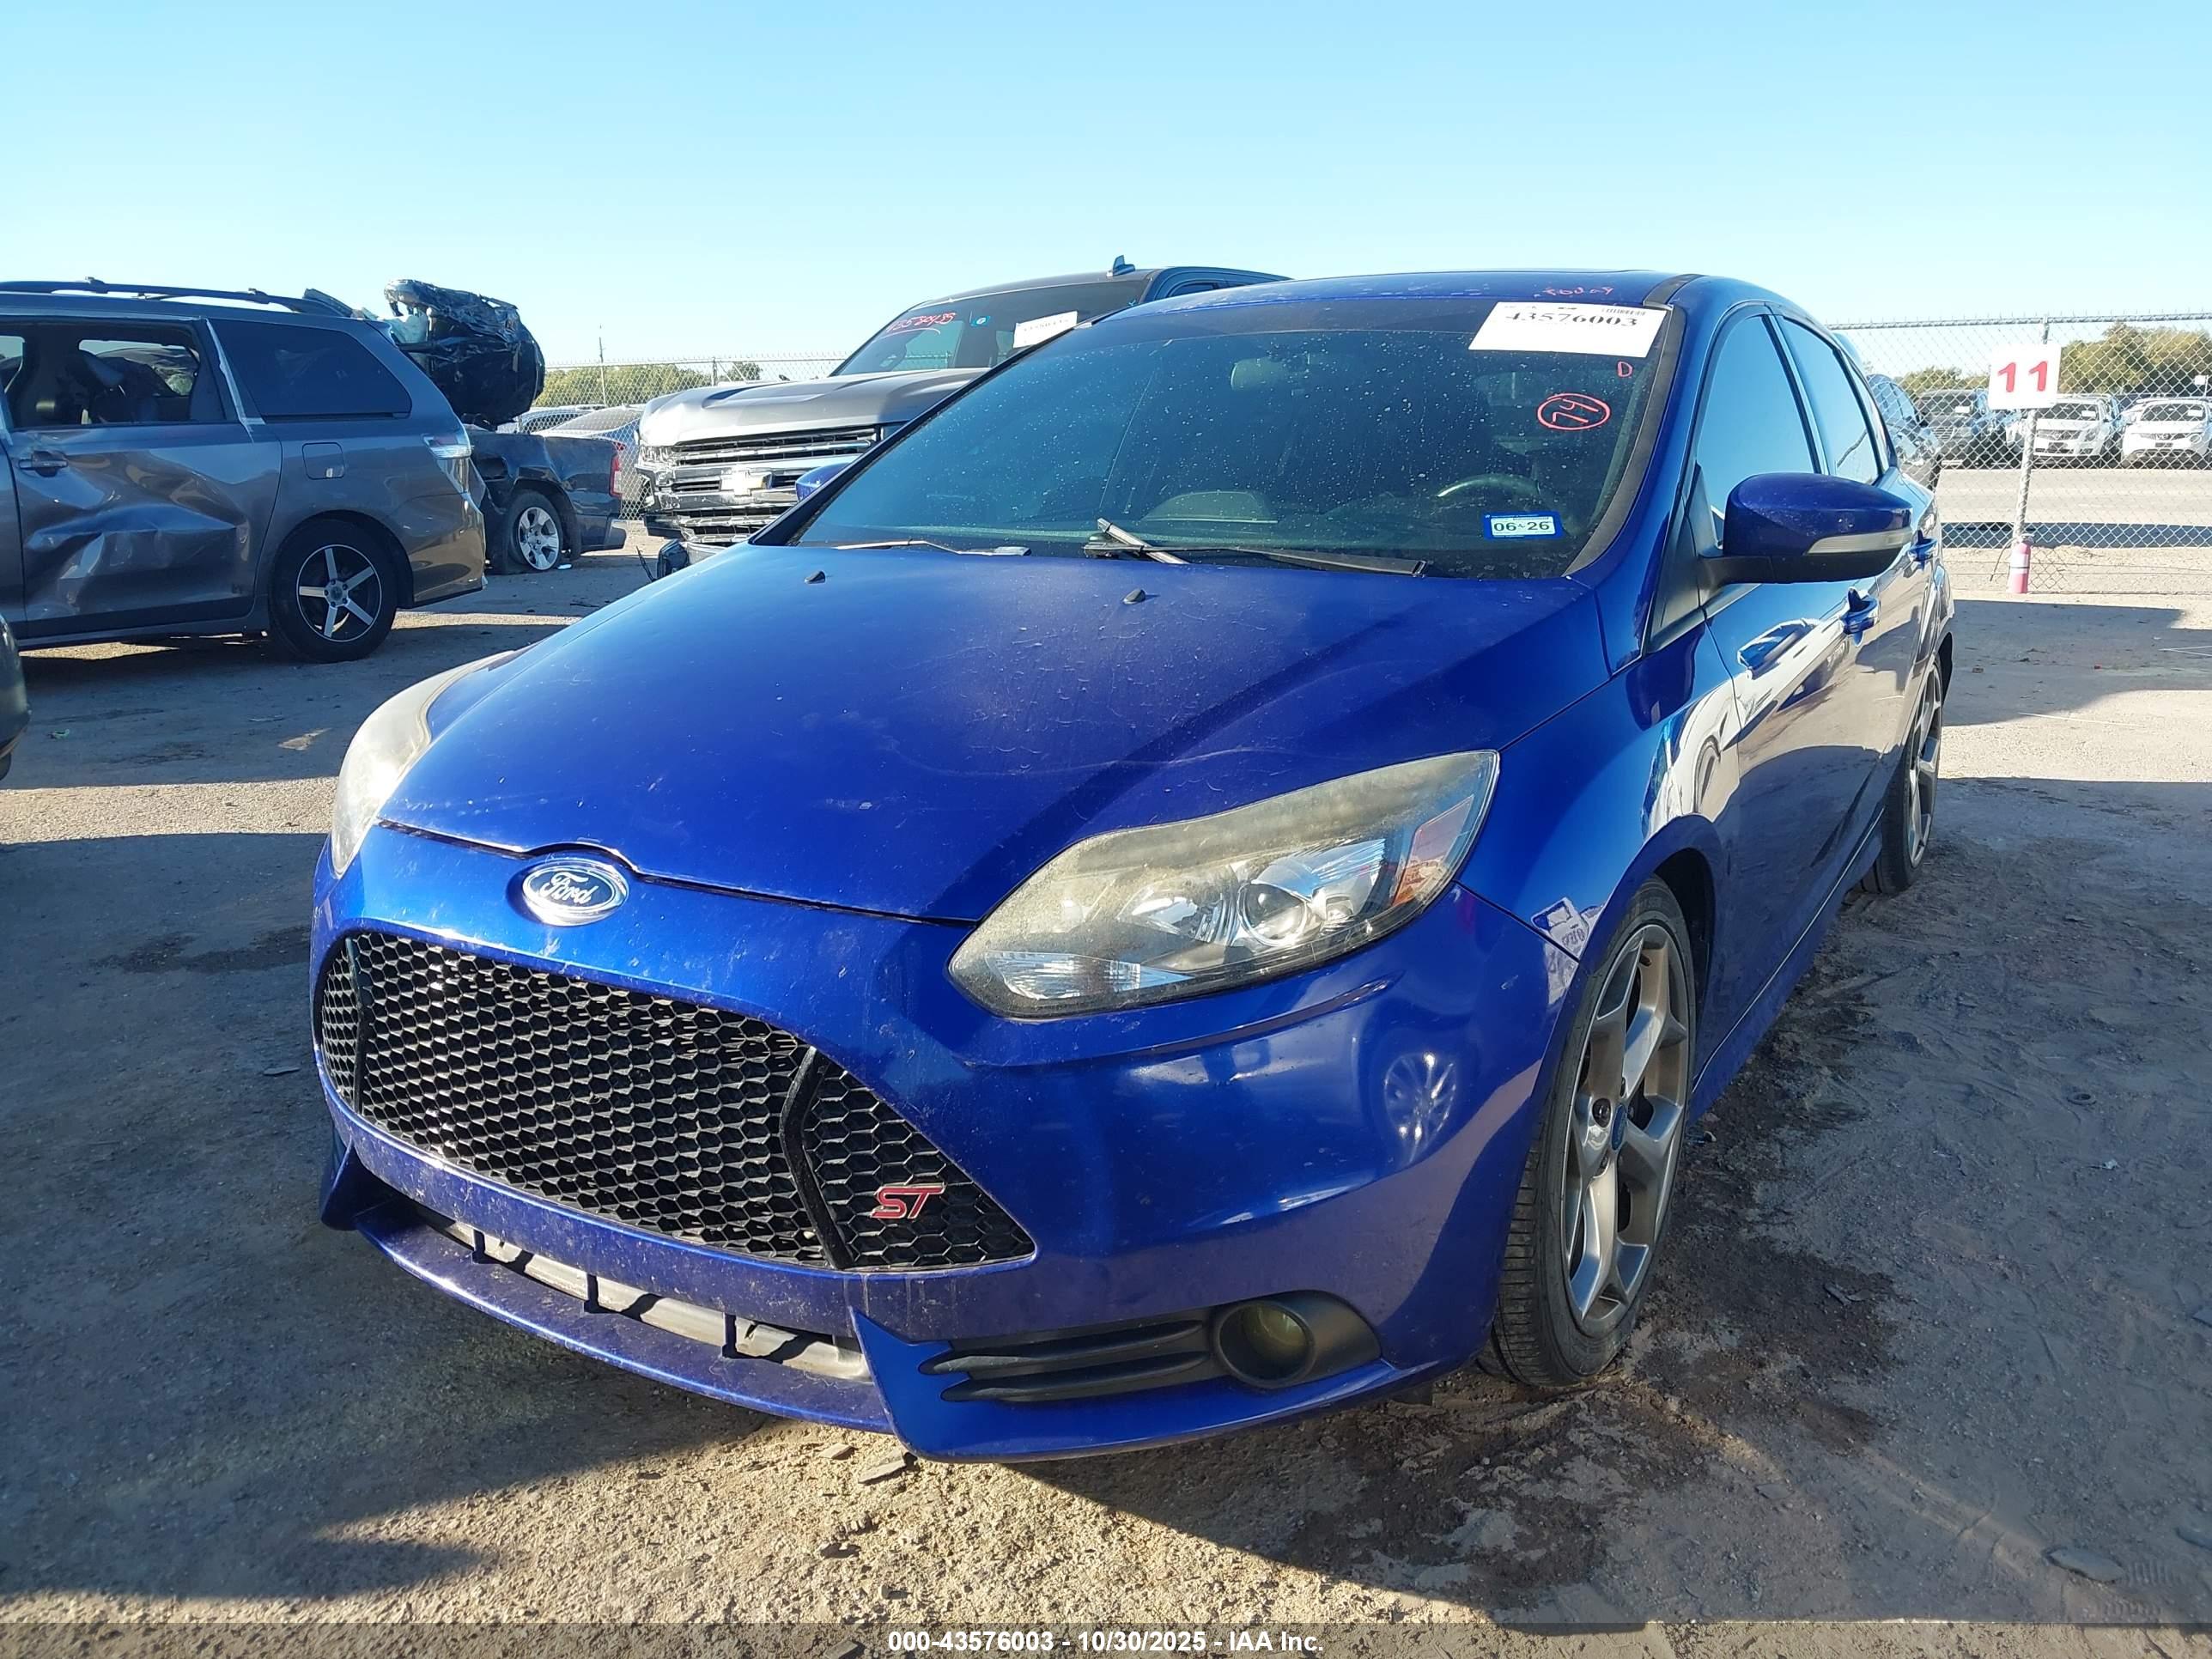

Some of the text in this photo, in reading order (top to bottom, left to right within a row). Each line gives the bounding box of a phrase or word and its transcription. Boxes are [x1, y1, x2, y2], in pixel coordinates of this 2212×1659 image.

[1996, 361, 2049, 393] 11
[539, 871, 599, 905] Ford
[870, 1182, 946, 1219] ST
